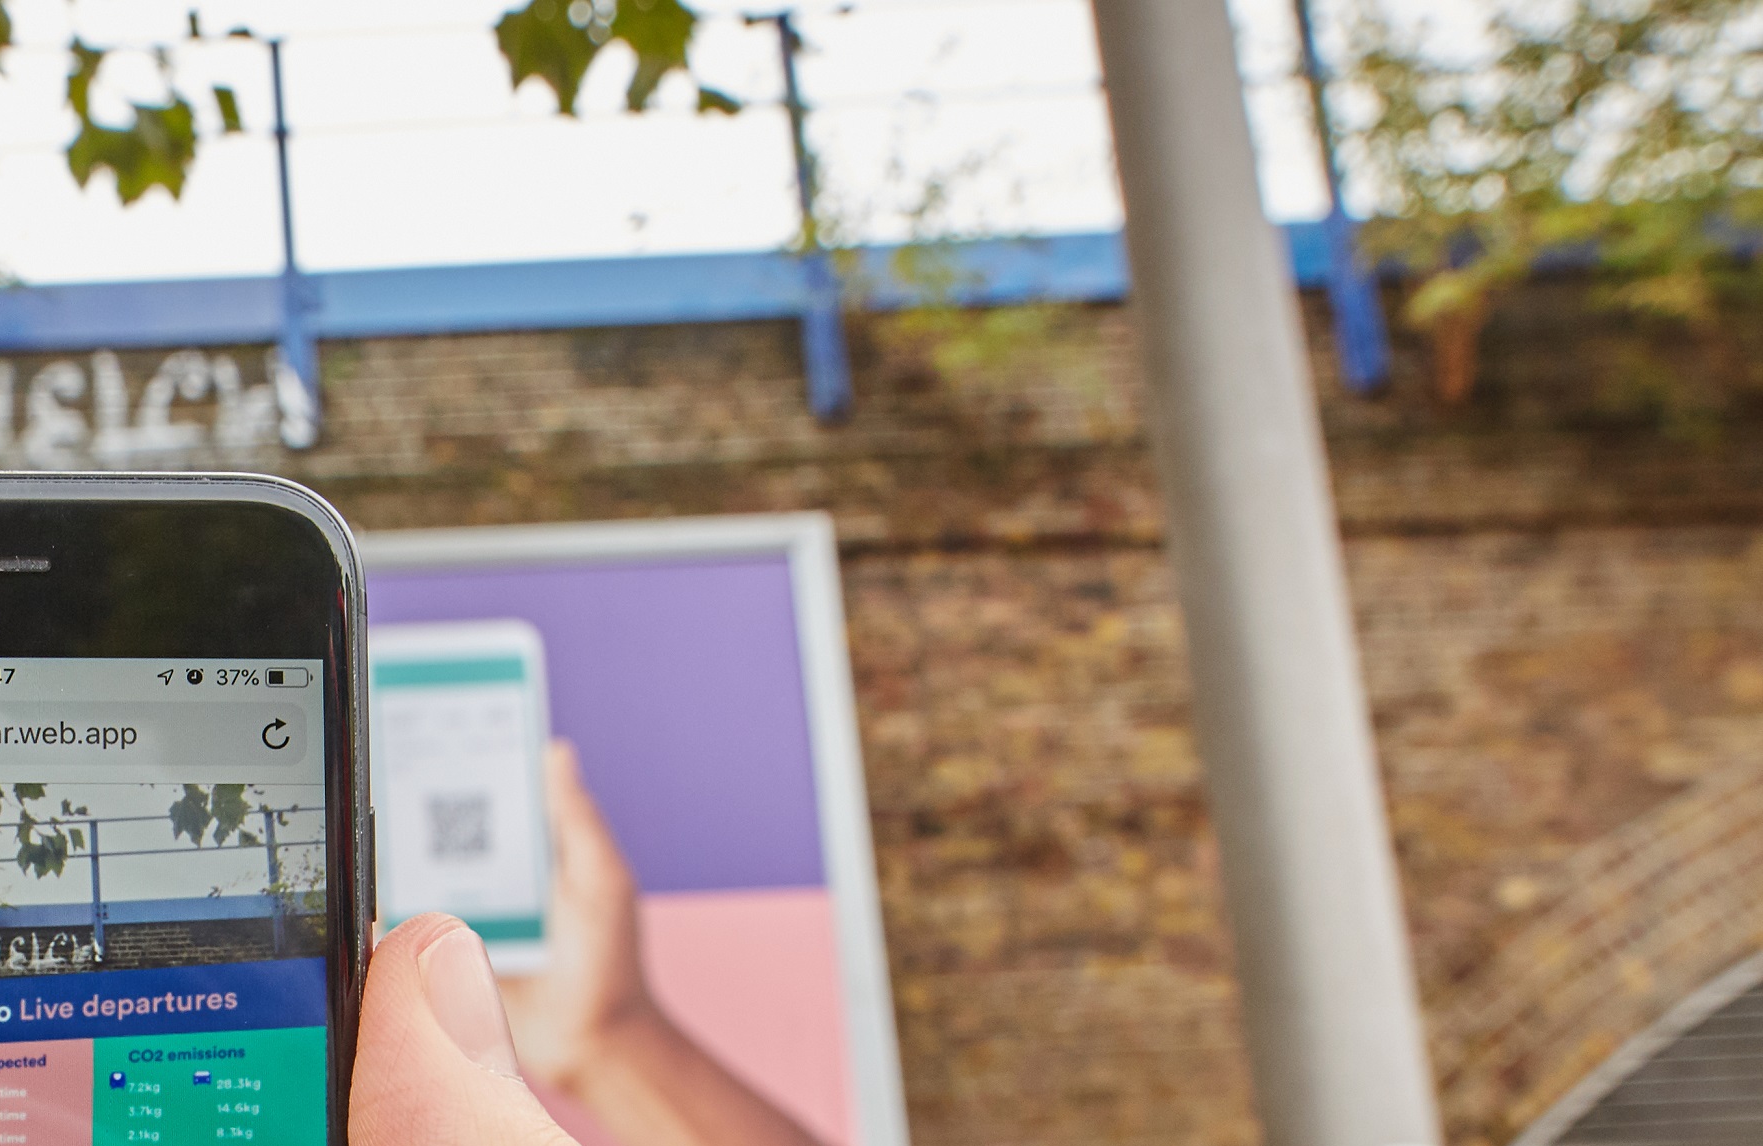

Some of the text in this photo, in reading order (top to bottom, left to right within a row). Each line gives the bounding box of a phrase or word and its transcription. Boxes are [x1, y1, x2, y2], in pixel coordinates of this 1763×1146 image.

[217, 669, 259, 686] 37%
[20, 998, 74, 1020] Live
[82, 992, 238, 1020] departures
[128, 1049, 163, 1063] CO2
[167, 1046, 245, 1061] emissions
[0, 1087, 26, 1098] time
[0, 1110, 26, 1121] time
[0, 1133, 26, 1144] time
